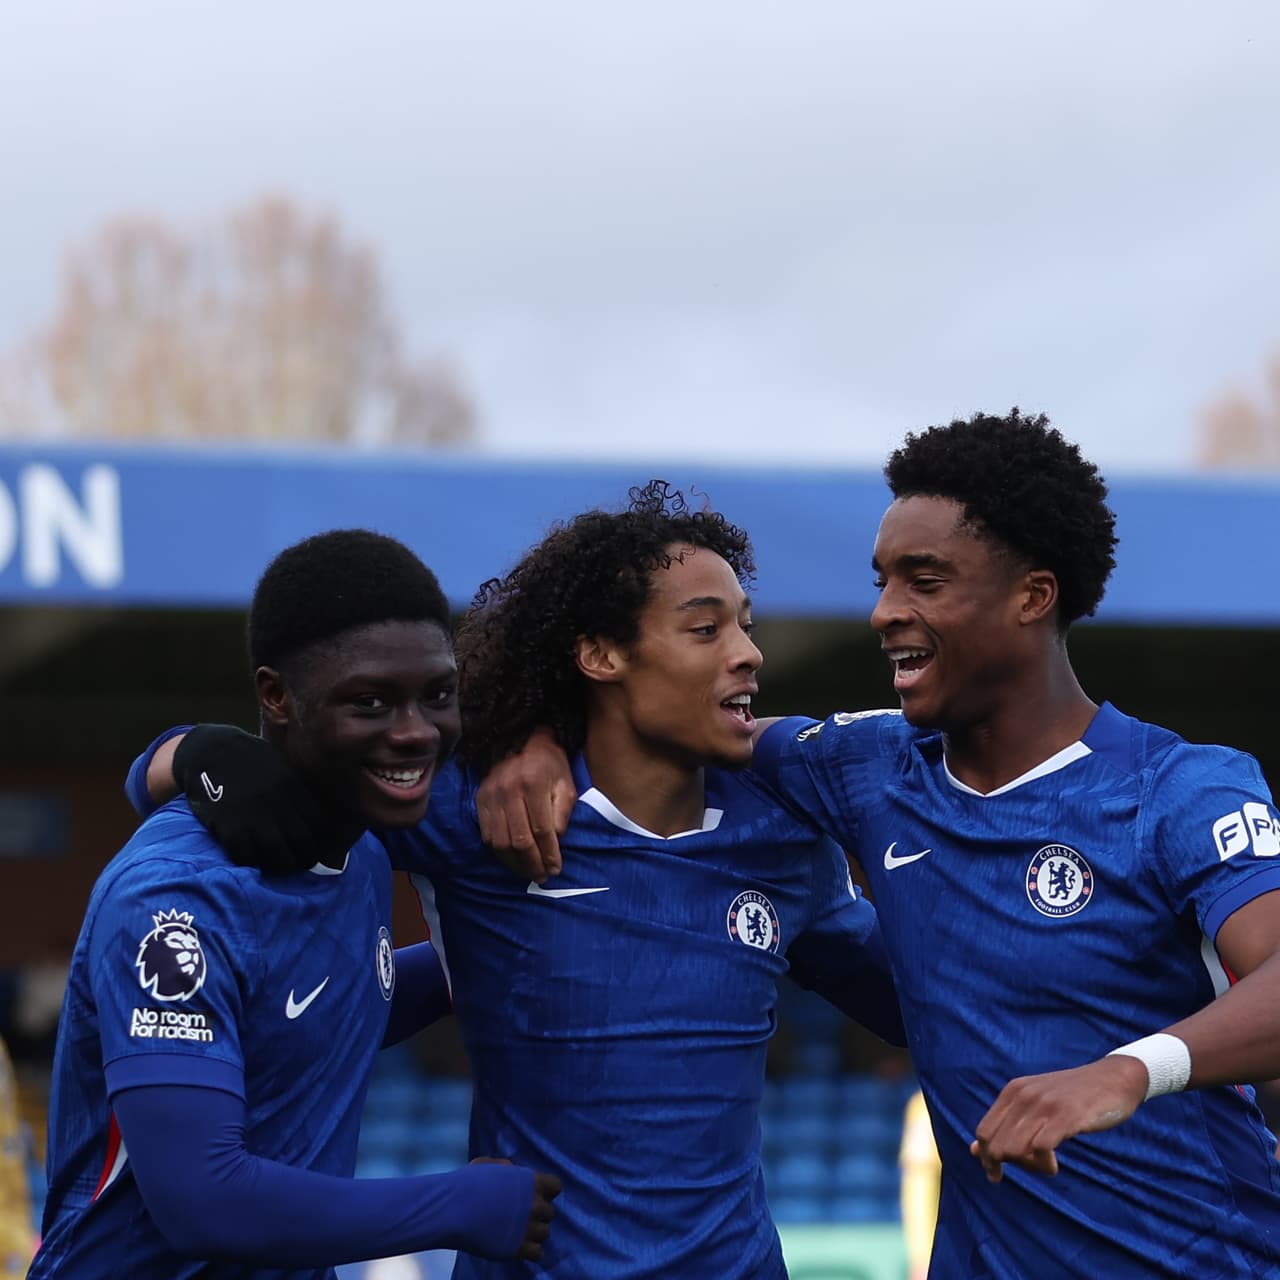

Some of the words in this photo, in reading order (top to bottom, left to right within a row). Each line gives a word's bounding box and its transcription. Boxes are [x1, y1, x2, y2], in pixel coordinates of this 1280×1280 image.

[1039, 847, 1080, 865] CHELSEA
[737, 893, 771, 912] CHELSEA
[132, 1008, 158, 1025] No
[161, 1011, 206, 1027] room
[130, 1022, 157, 1037] for
[158, 1025, 214, 1042] racism
